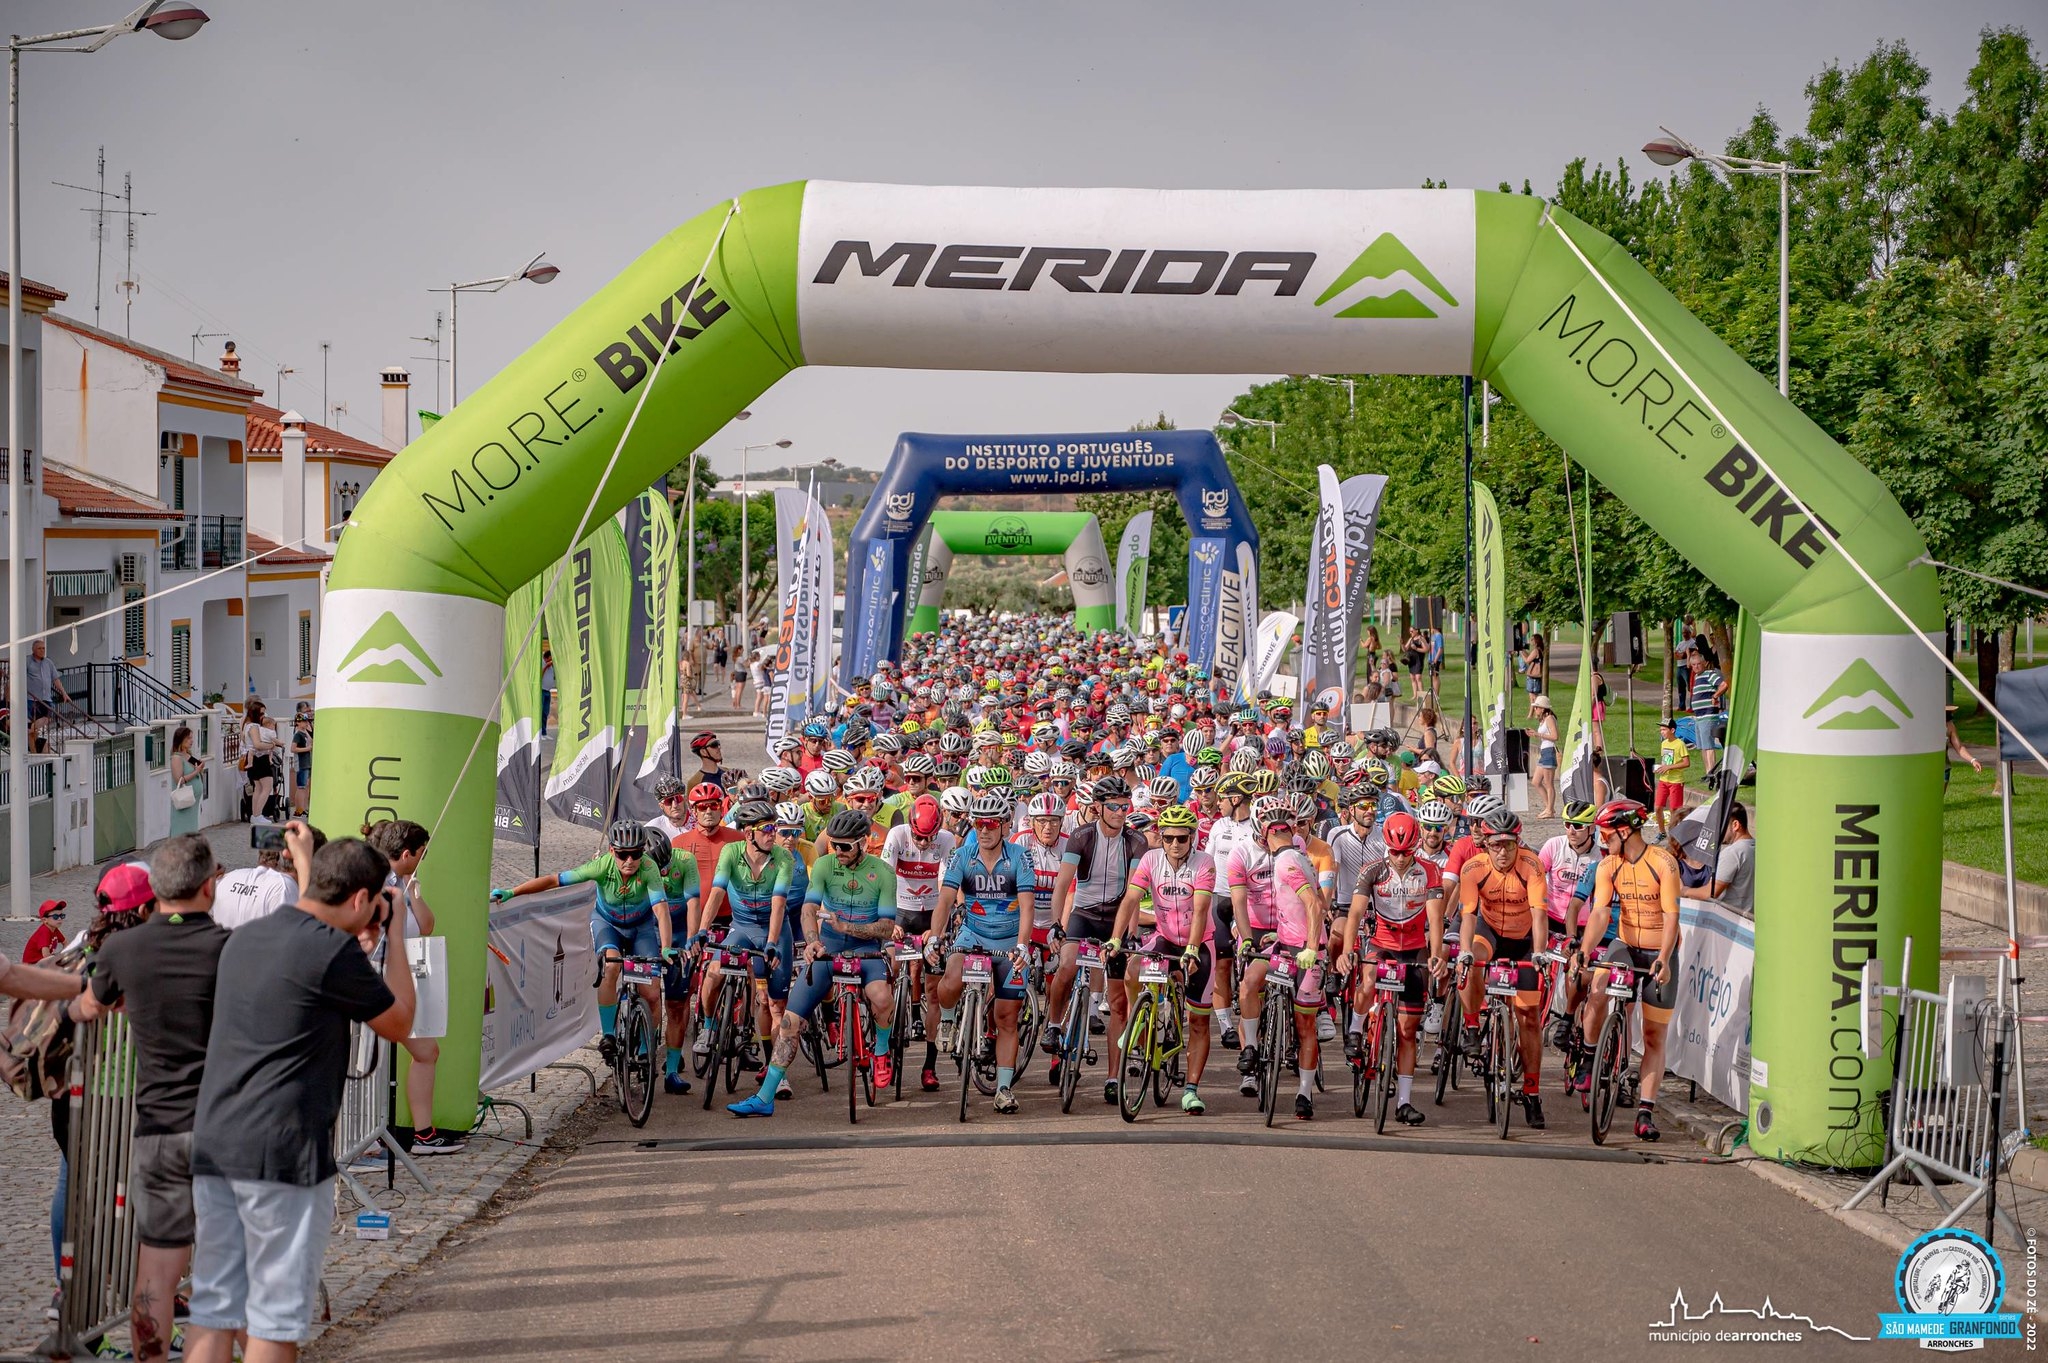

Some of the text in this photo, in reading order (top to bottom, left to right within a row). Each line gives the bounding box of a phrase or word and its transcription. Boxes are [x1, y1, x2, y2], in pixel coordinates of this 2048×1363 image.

[812, 239, 1317, 297] MERIDA
[593, 272, 731, 395] BIKE
[965, 439, 1153, 456] INSTITUTO PORTUGUÊS
[945, 453, 1175, 470] DO DESPORTO E JUVENTUDE
[1010, 470, 1108, 486] www.ipdj.pt
[1703, 443, 1841, 570] BIKE
[986, 535, 1032, 546] AVENTURA
[974, 874, 1007, 892] DAP
